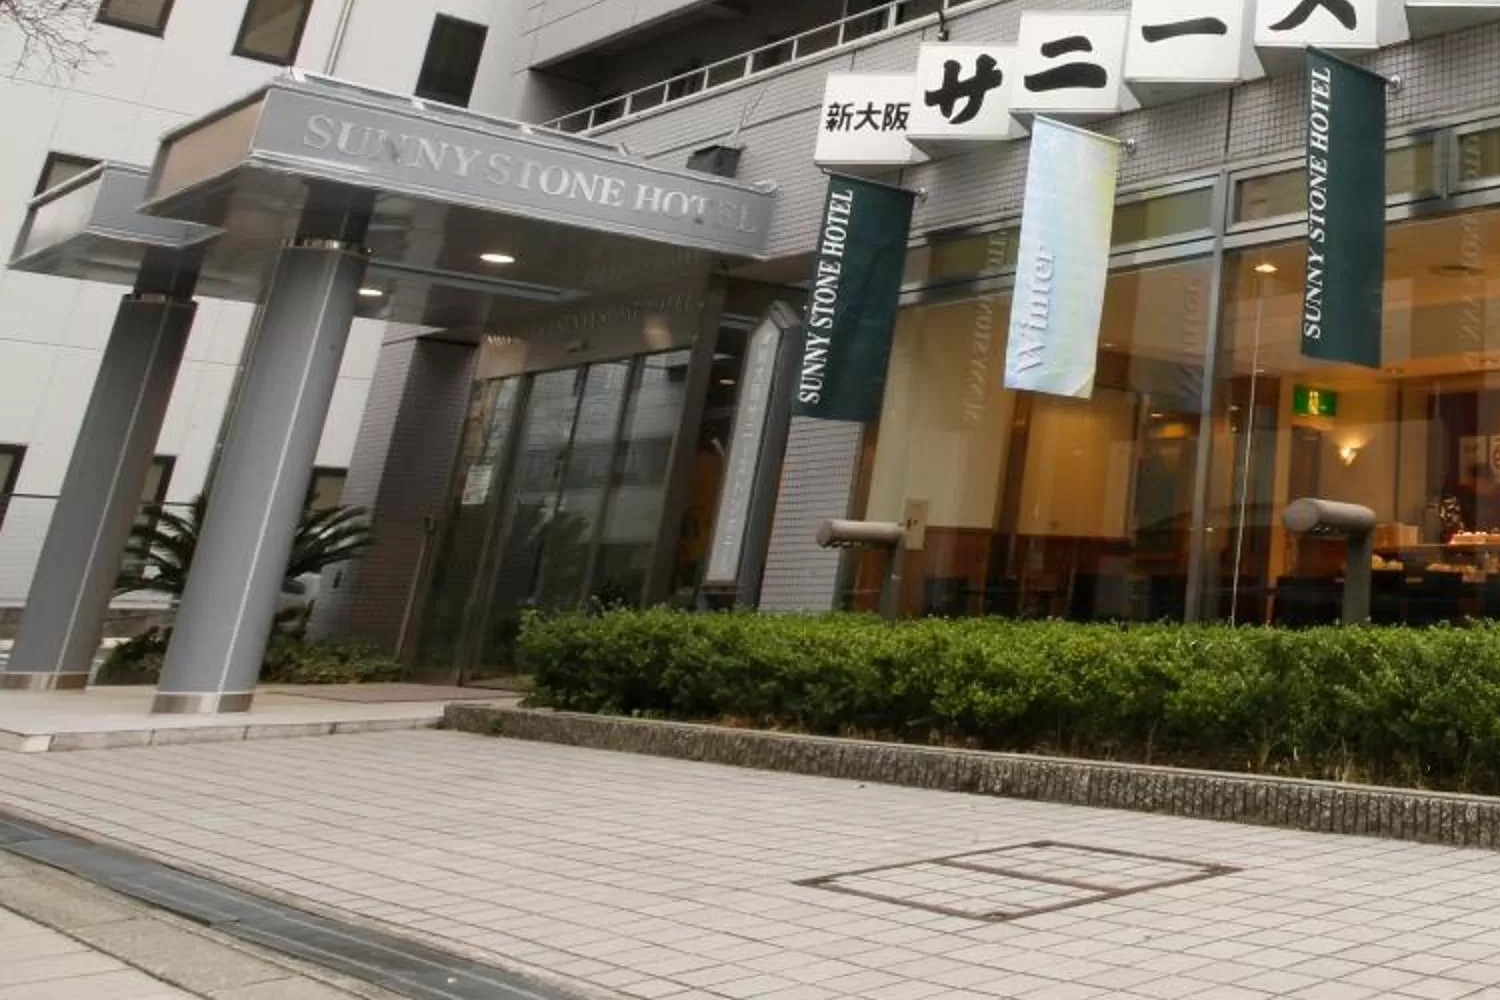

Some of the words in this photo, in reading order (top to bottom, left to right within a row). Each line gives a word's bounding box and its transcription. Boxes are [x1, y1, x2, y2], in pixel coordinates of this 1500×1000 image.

[824, 102, 912, 133] 新大阪
[1310, 67, 1332, 151] HOTEL
[303, 114, 482, 178] SUNNY
[486, 151, 625, 208] STONE
[633, 182, 757, 233] HOTEL
[1308, 155, 1328, 243] STONE
[822, 189, 854, 258] HOTEL
[811, 259, 843, 329] STONE
[1016, 244, 1057, 375] Winter
[1304, 247, 1326, 340] SUNNY
[799, 329, 832, 405] SUNNY
